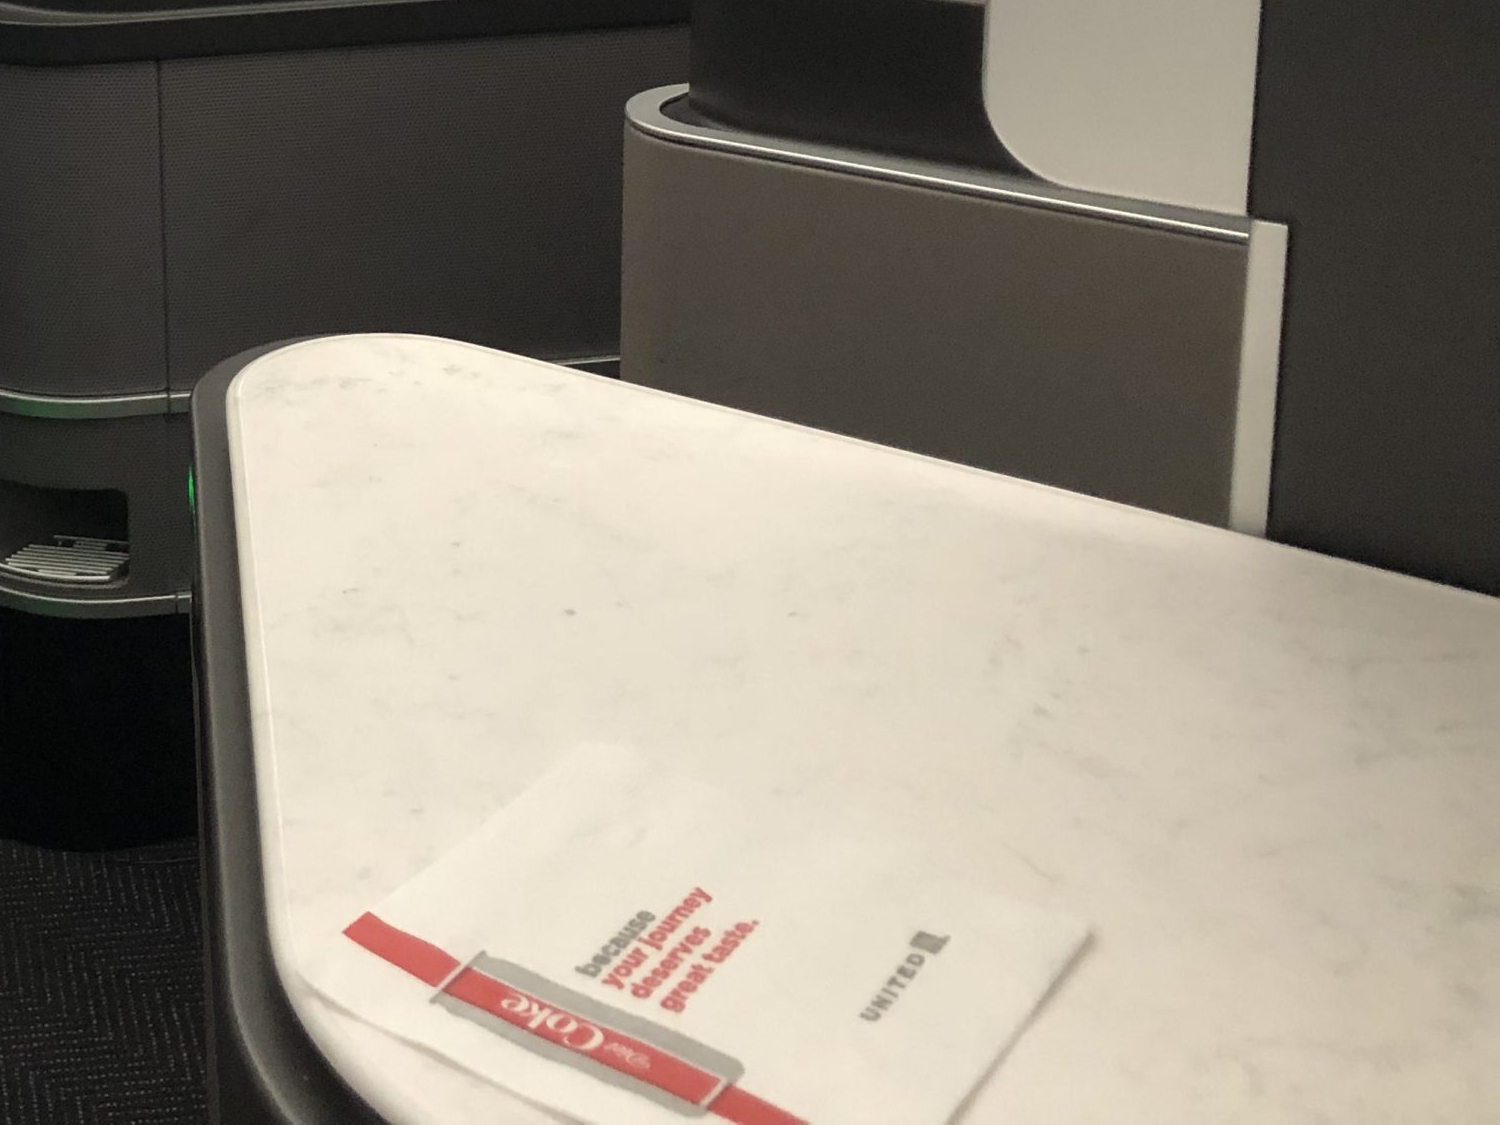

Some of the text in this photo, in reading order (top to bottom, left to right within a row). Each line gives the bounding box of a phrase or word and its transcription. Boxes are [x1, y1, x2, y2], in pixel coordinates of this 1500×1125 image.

[575, 910, 656, 978] because
[601, 886, 713, 990] your journey
[631, 926, 712, 999] deserves
[660, 919, 760, 1013] great taste.
[501, 992, 604, 1051] Coke
[859, 953, 926, 1022] UNITED
